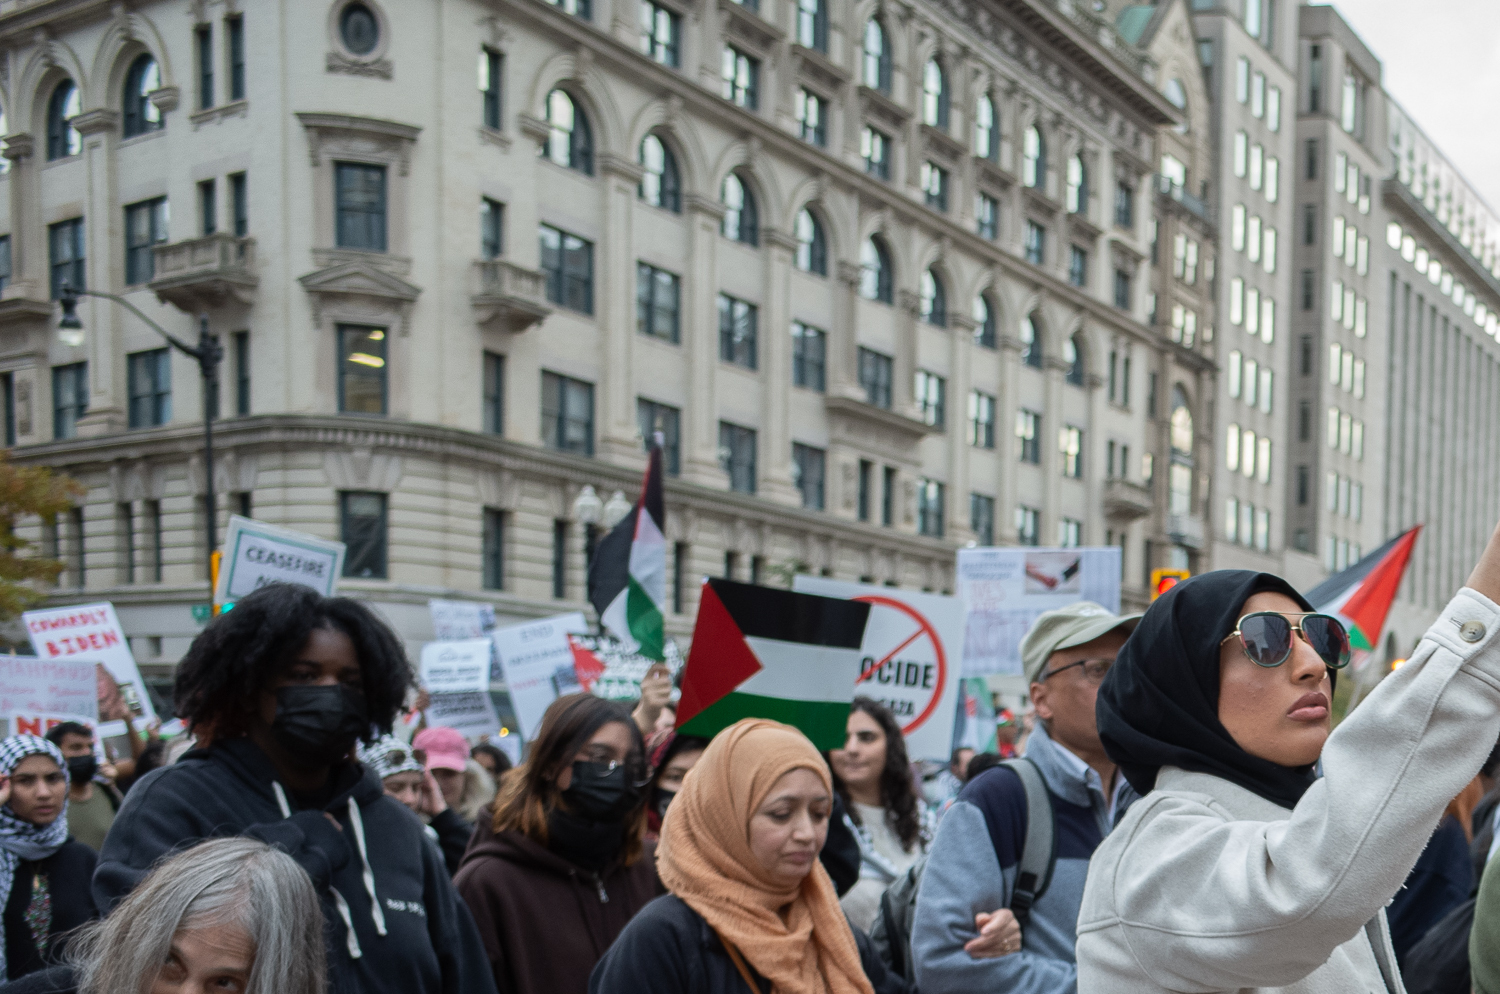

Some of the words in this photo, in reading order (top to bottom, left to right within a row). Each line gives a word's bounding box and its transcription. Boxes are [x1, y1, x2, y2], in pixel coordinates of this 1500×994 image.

[246, 546, 324, 578] CEASEFIRE
[30, 609, 108, 634] COWARDLY
[46, 630, 119, 657] BIDEN
[880, 699, 914, 716] AZA
